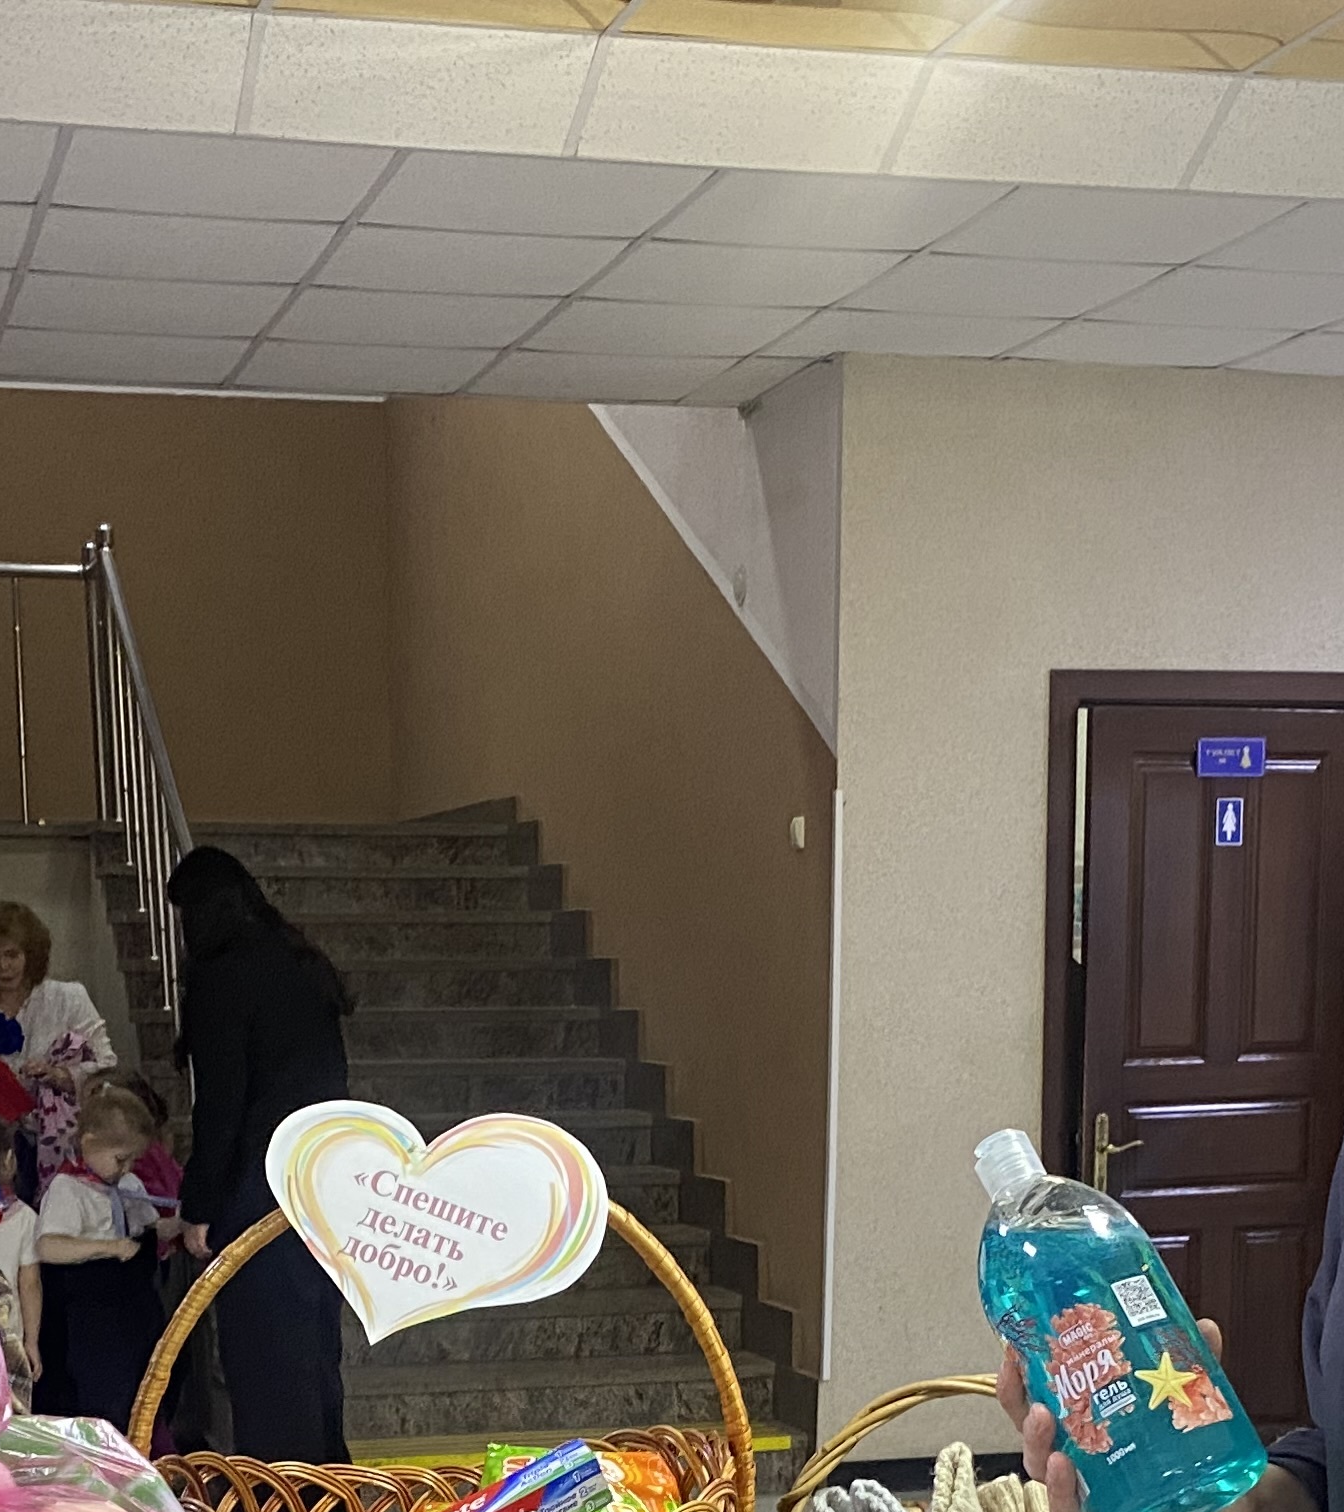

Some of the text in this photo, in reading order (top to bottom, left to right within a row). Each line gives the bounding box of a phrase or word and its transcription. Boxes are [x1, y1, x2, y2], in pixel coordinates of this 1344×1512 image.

[353, 1169, 508, 1242] «Спешите
[338, 1234, 458, 1291] добро!»
[357, 1207, 464, 1263] делать
[1063, 1322, 1094, 1347] MAGIC
[1055, 1348, 1119, 1408] Моря
